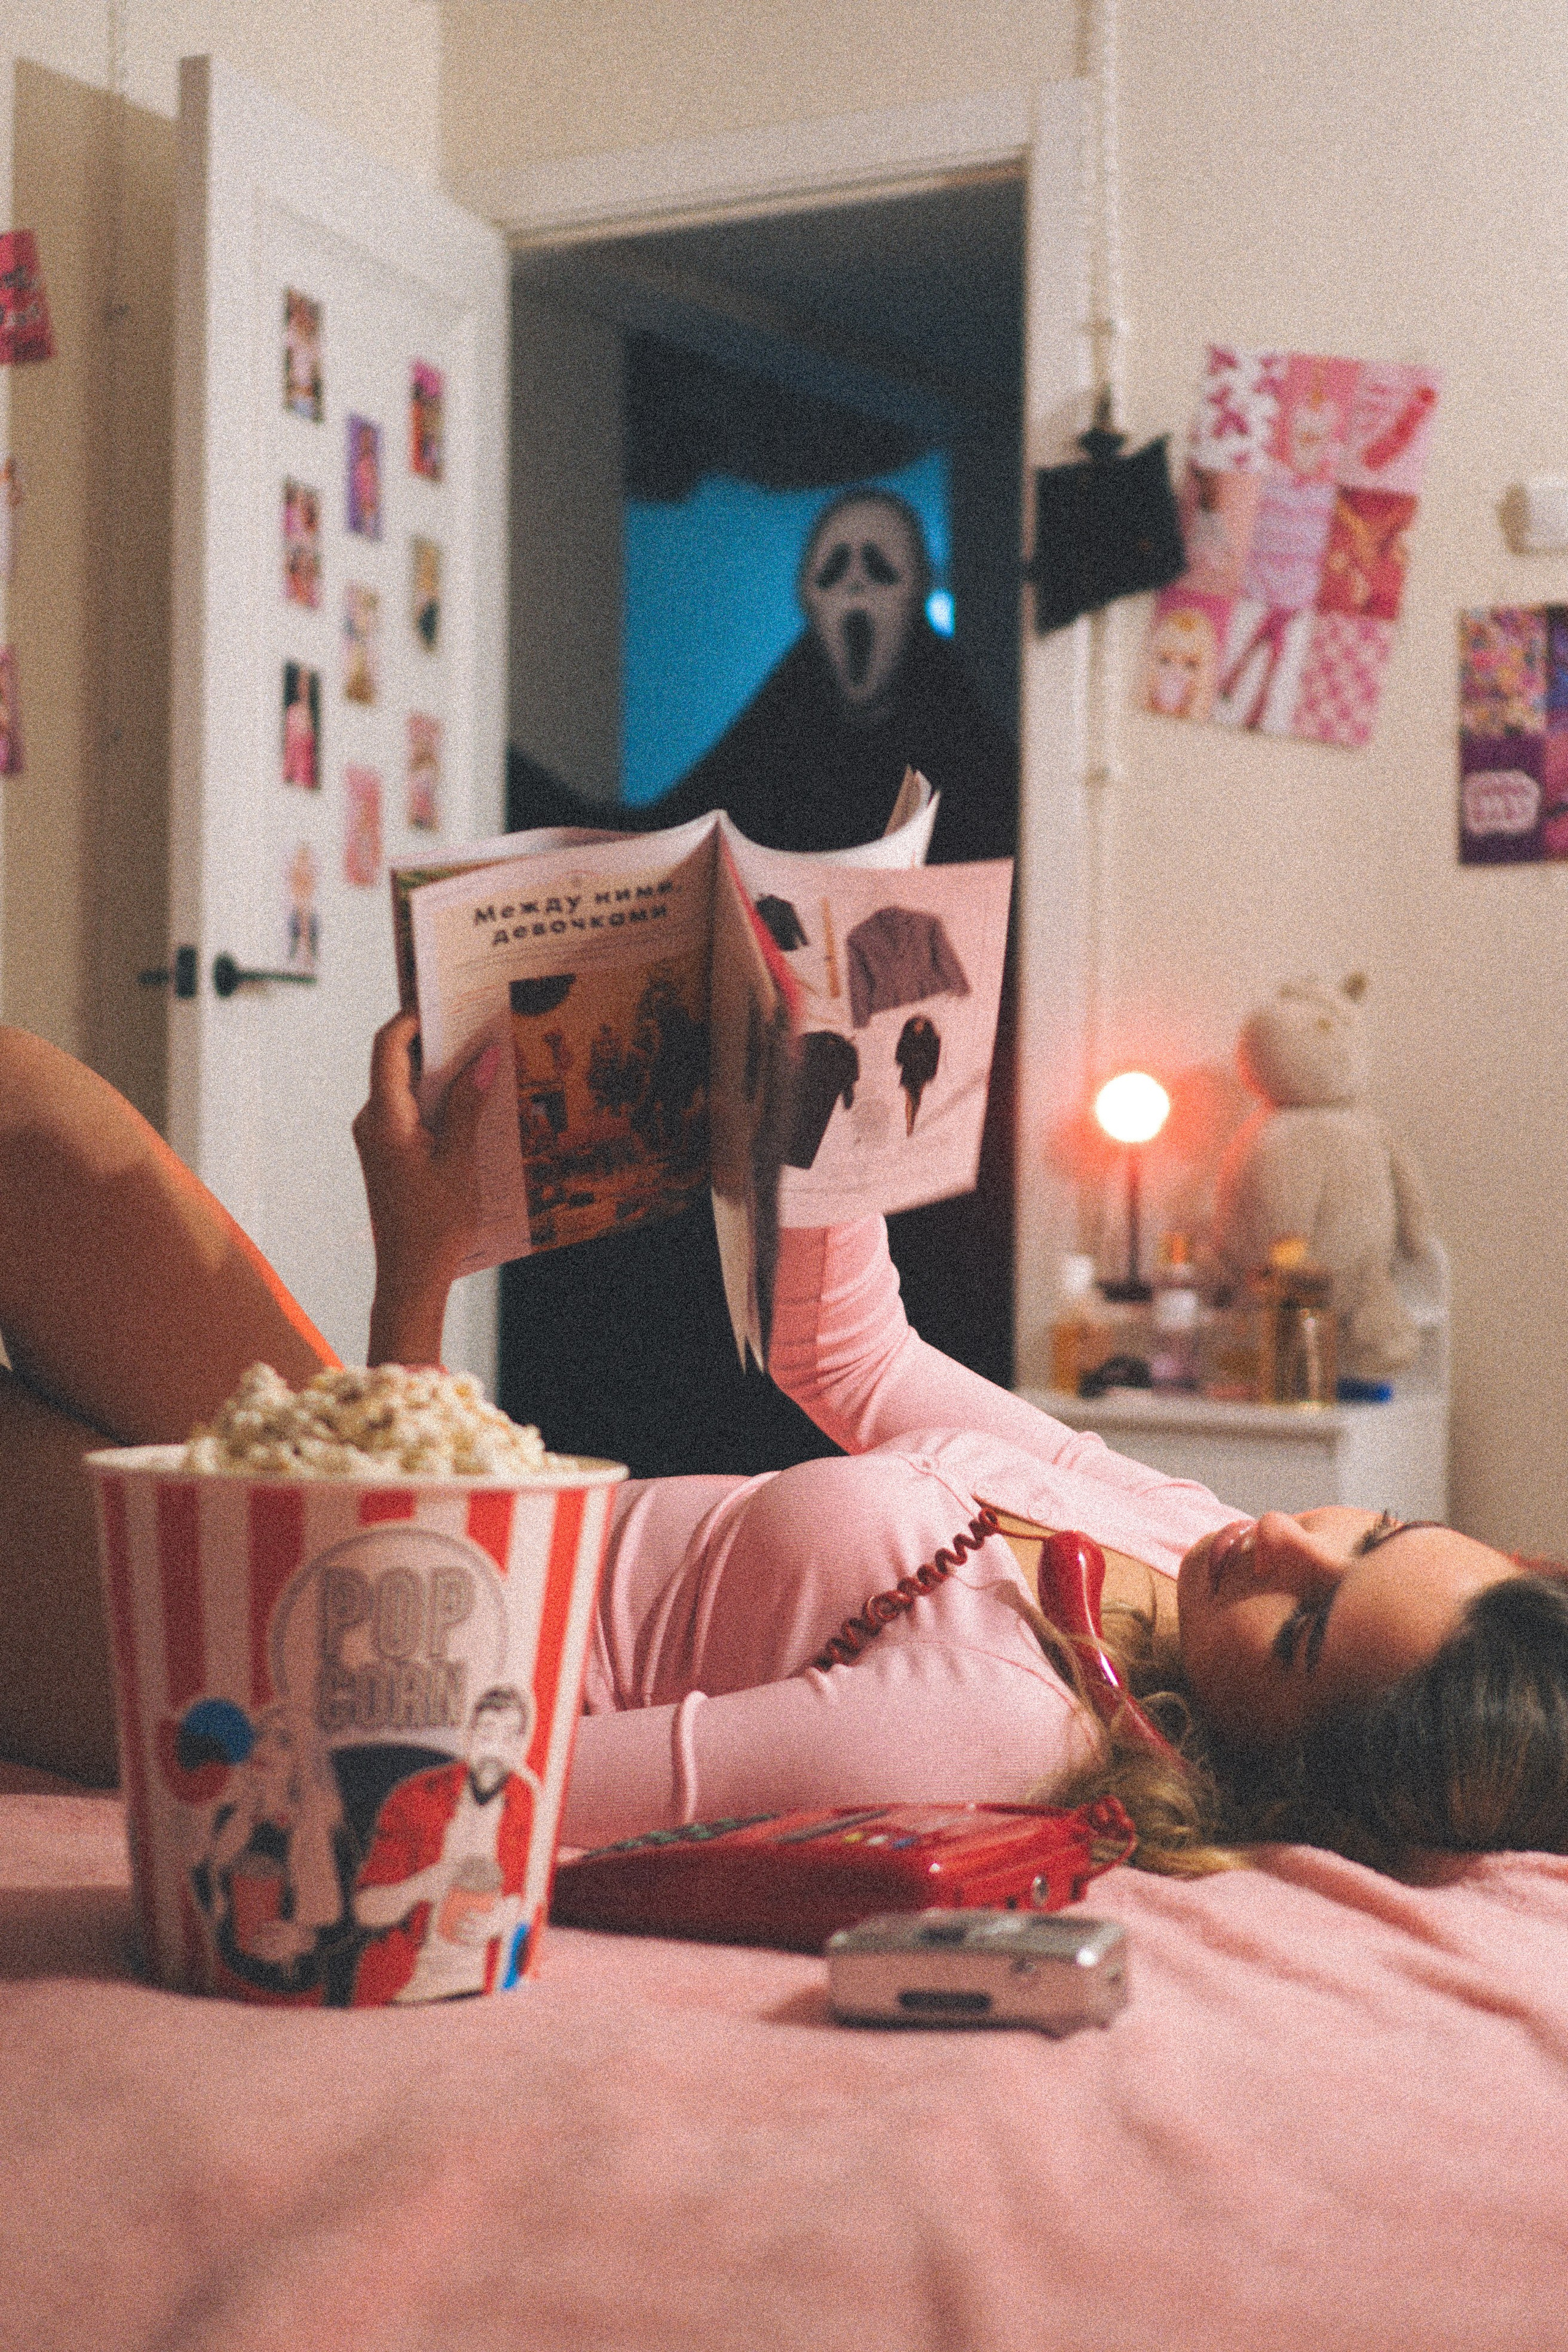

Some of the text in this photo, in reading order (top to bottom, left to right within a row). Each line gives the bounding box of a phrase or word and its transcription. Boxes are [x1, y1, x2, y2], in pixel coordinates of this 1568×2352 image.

[474, 895, 581, 925] Между
[317, 1566, 477, 1660] POP
[315, 1659, 469, 1734] CORN
